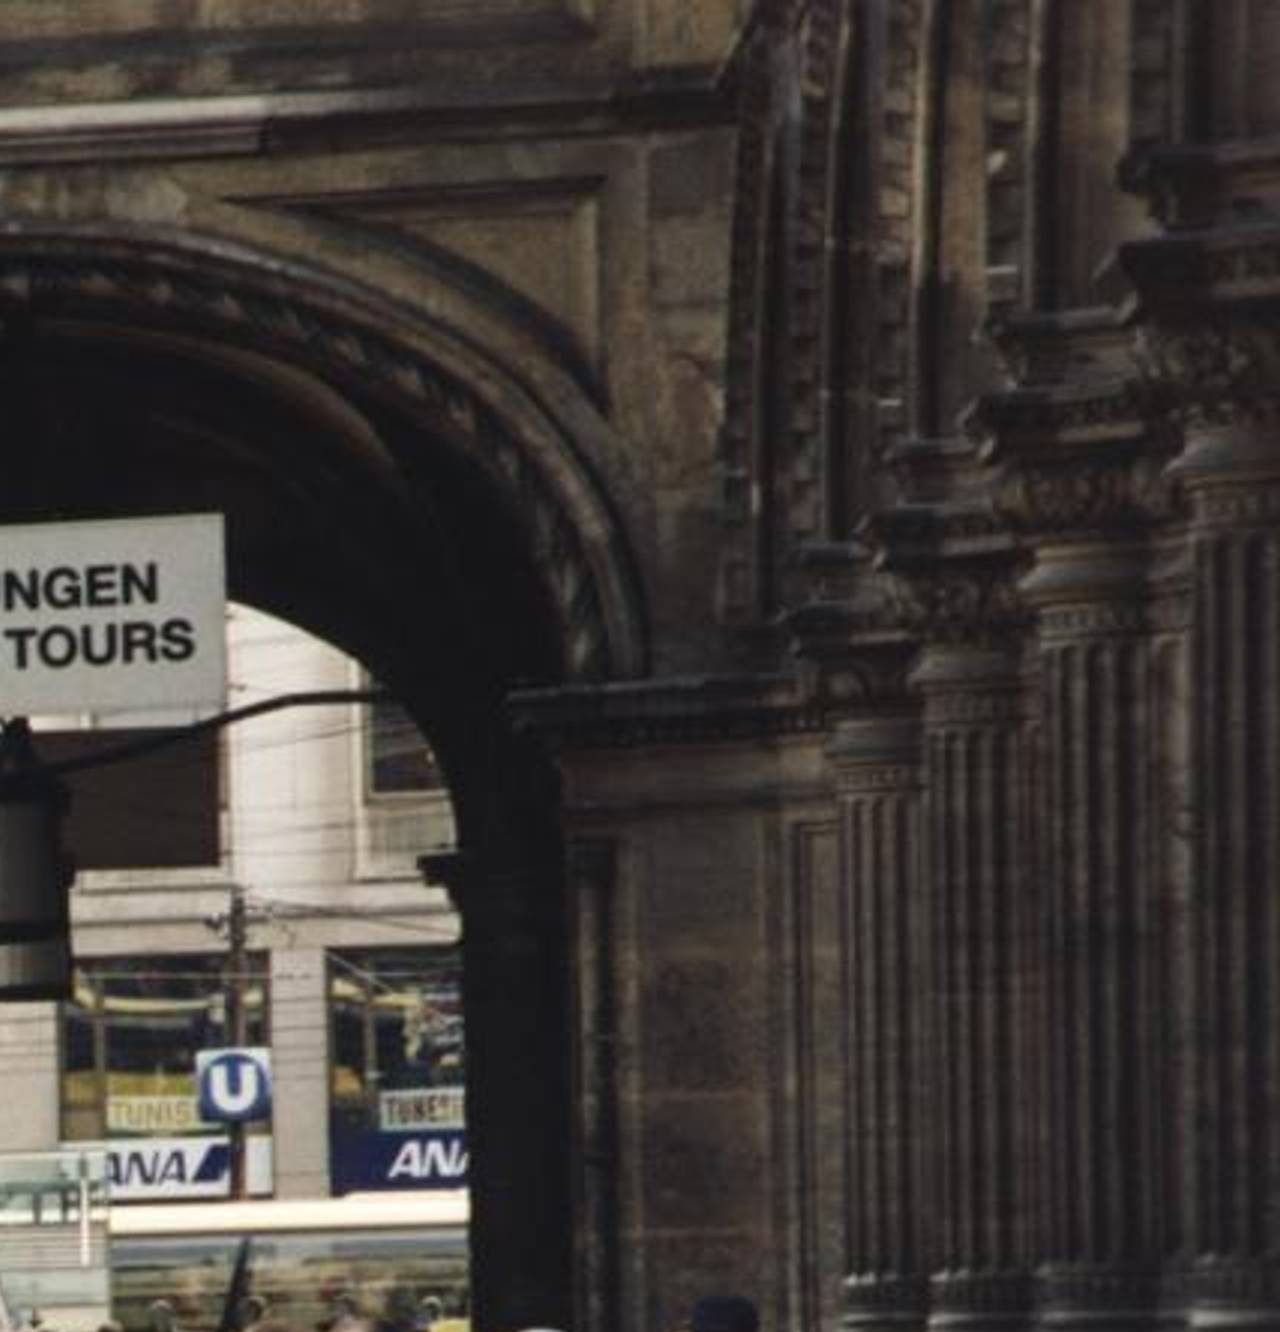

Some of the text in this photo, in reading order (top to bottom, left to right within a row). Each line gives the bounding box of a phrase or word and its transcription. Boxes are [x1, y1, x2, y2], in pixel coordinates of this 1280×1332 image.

[4, 619, 195, 669] TOURS
[209, 1062, 259, 1113] U
[388, 1139, 468, 1178] AN
